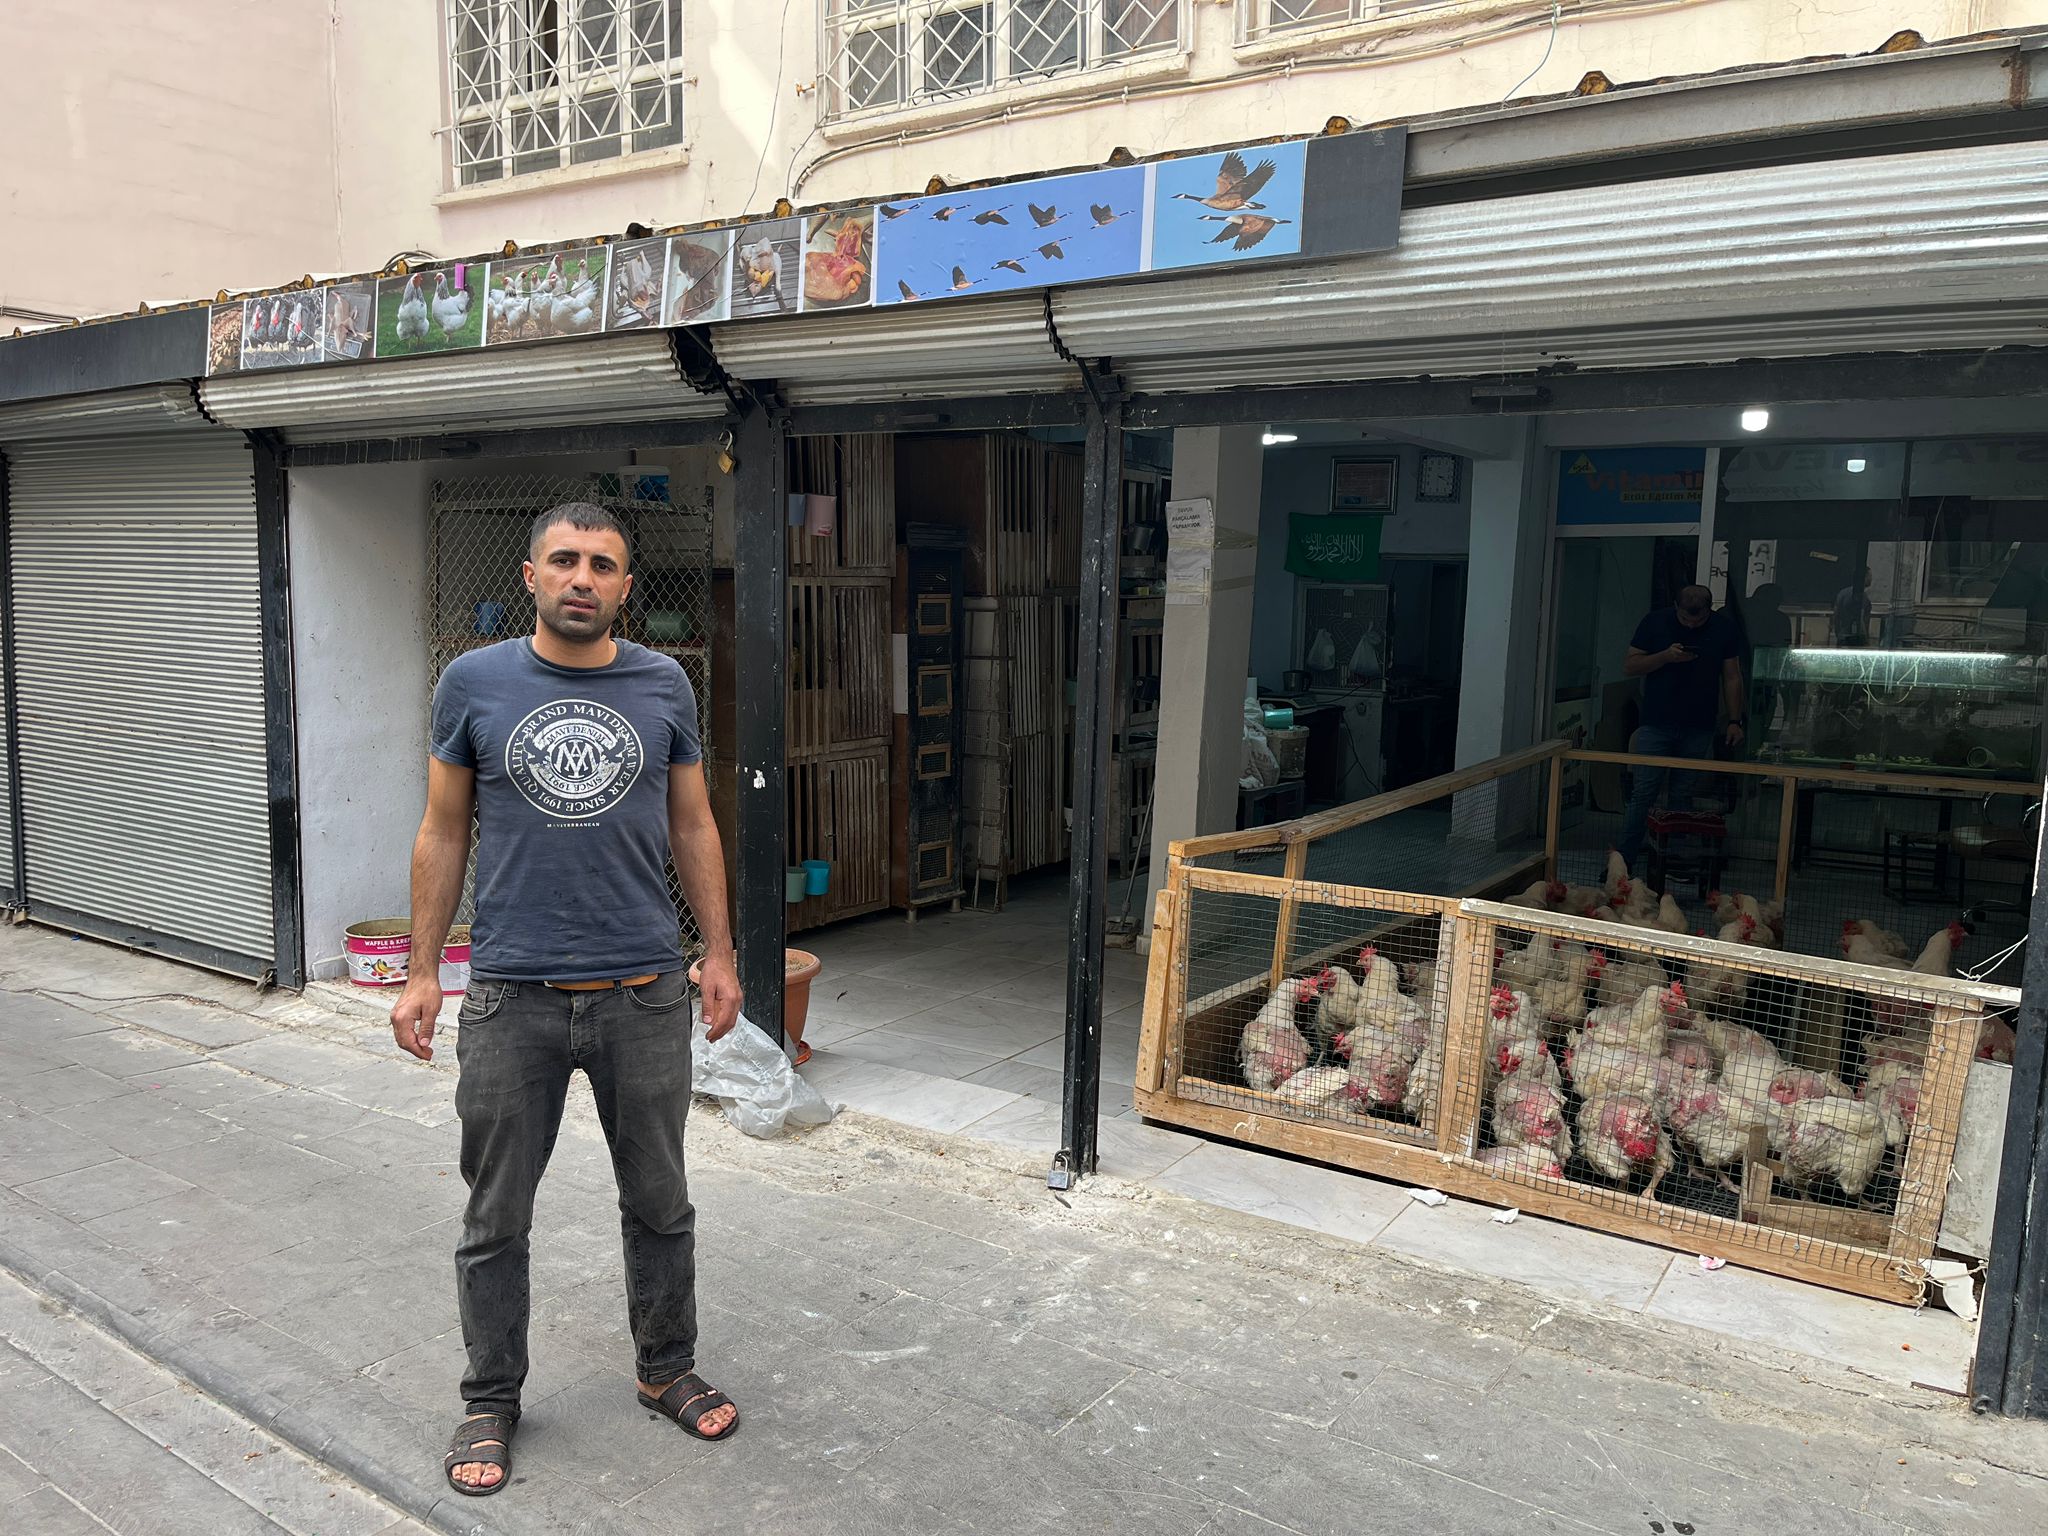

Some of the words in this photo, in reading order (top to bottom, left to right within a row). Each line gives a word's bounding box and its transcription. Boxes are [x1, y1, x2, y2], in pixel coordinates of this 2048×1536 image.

[521, 704, 567, 735] BRAND
[573, 704, 612, 721] MAVI
[547, 726, 572, 745] MAVI
[572, 725, 608, 745] DENIM
[608, 717, 637, 759] DENIM
[511, 738, 539, 794] QUALITY
[547, 773, 571, 792] 1991
[574, 776, 603, 792] SINCE
[607, 760, 638, 796] WEAR
[537, 791, 562, 810] 1991
[565, 794, 607, 813] SINCE
